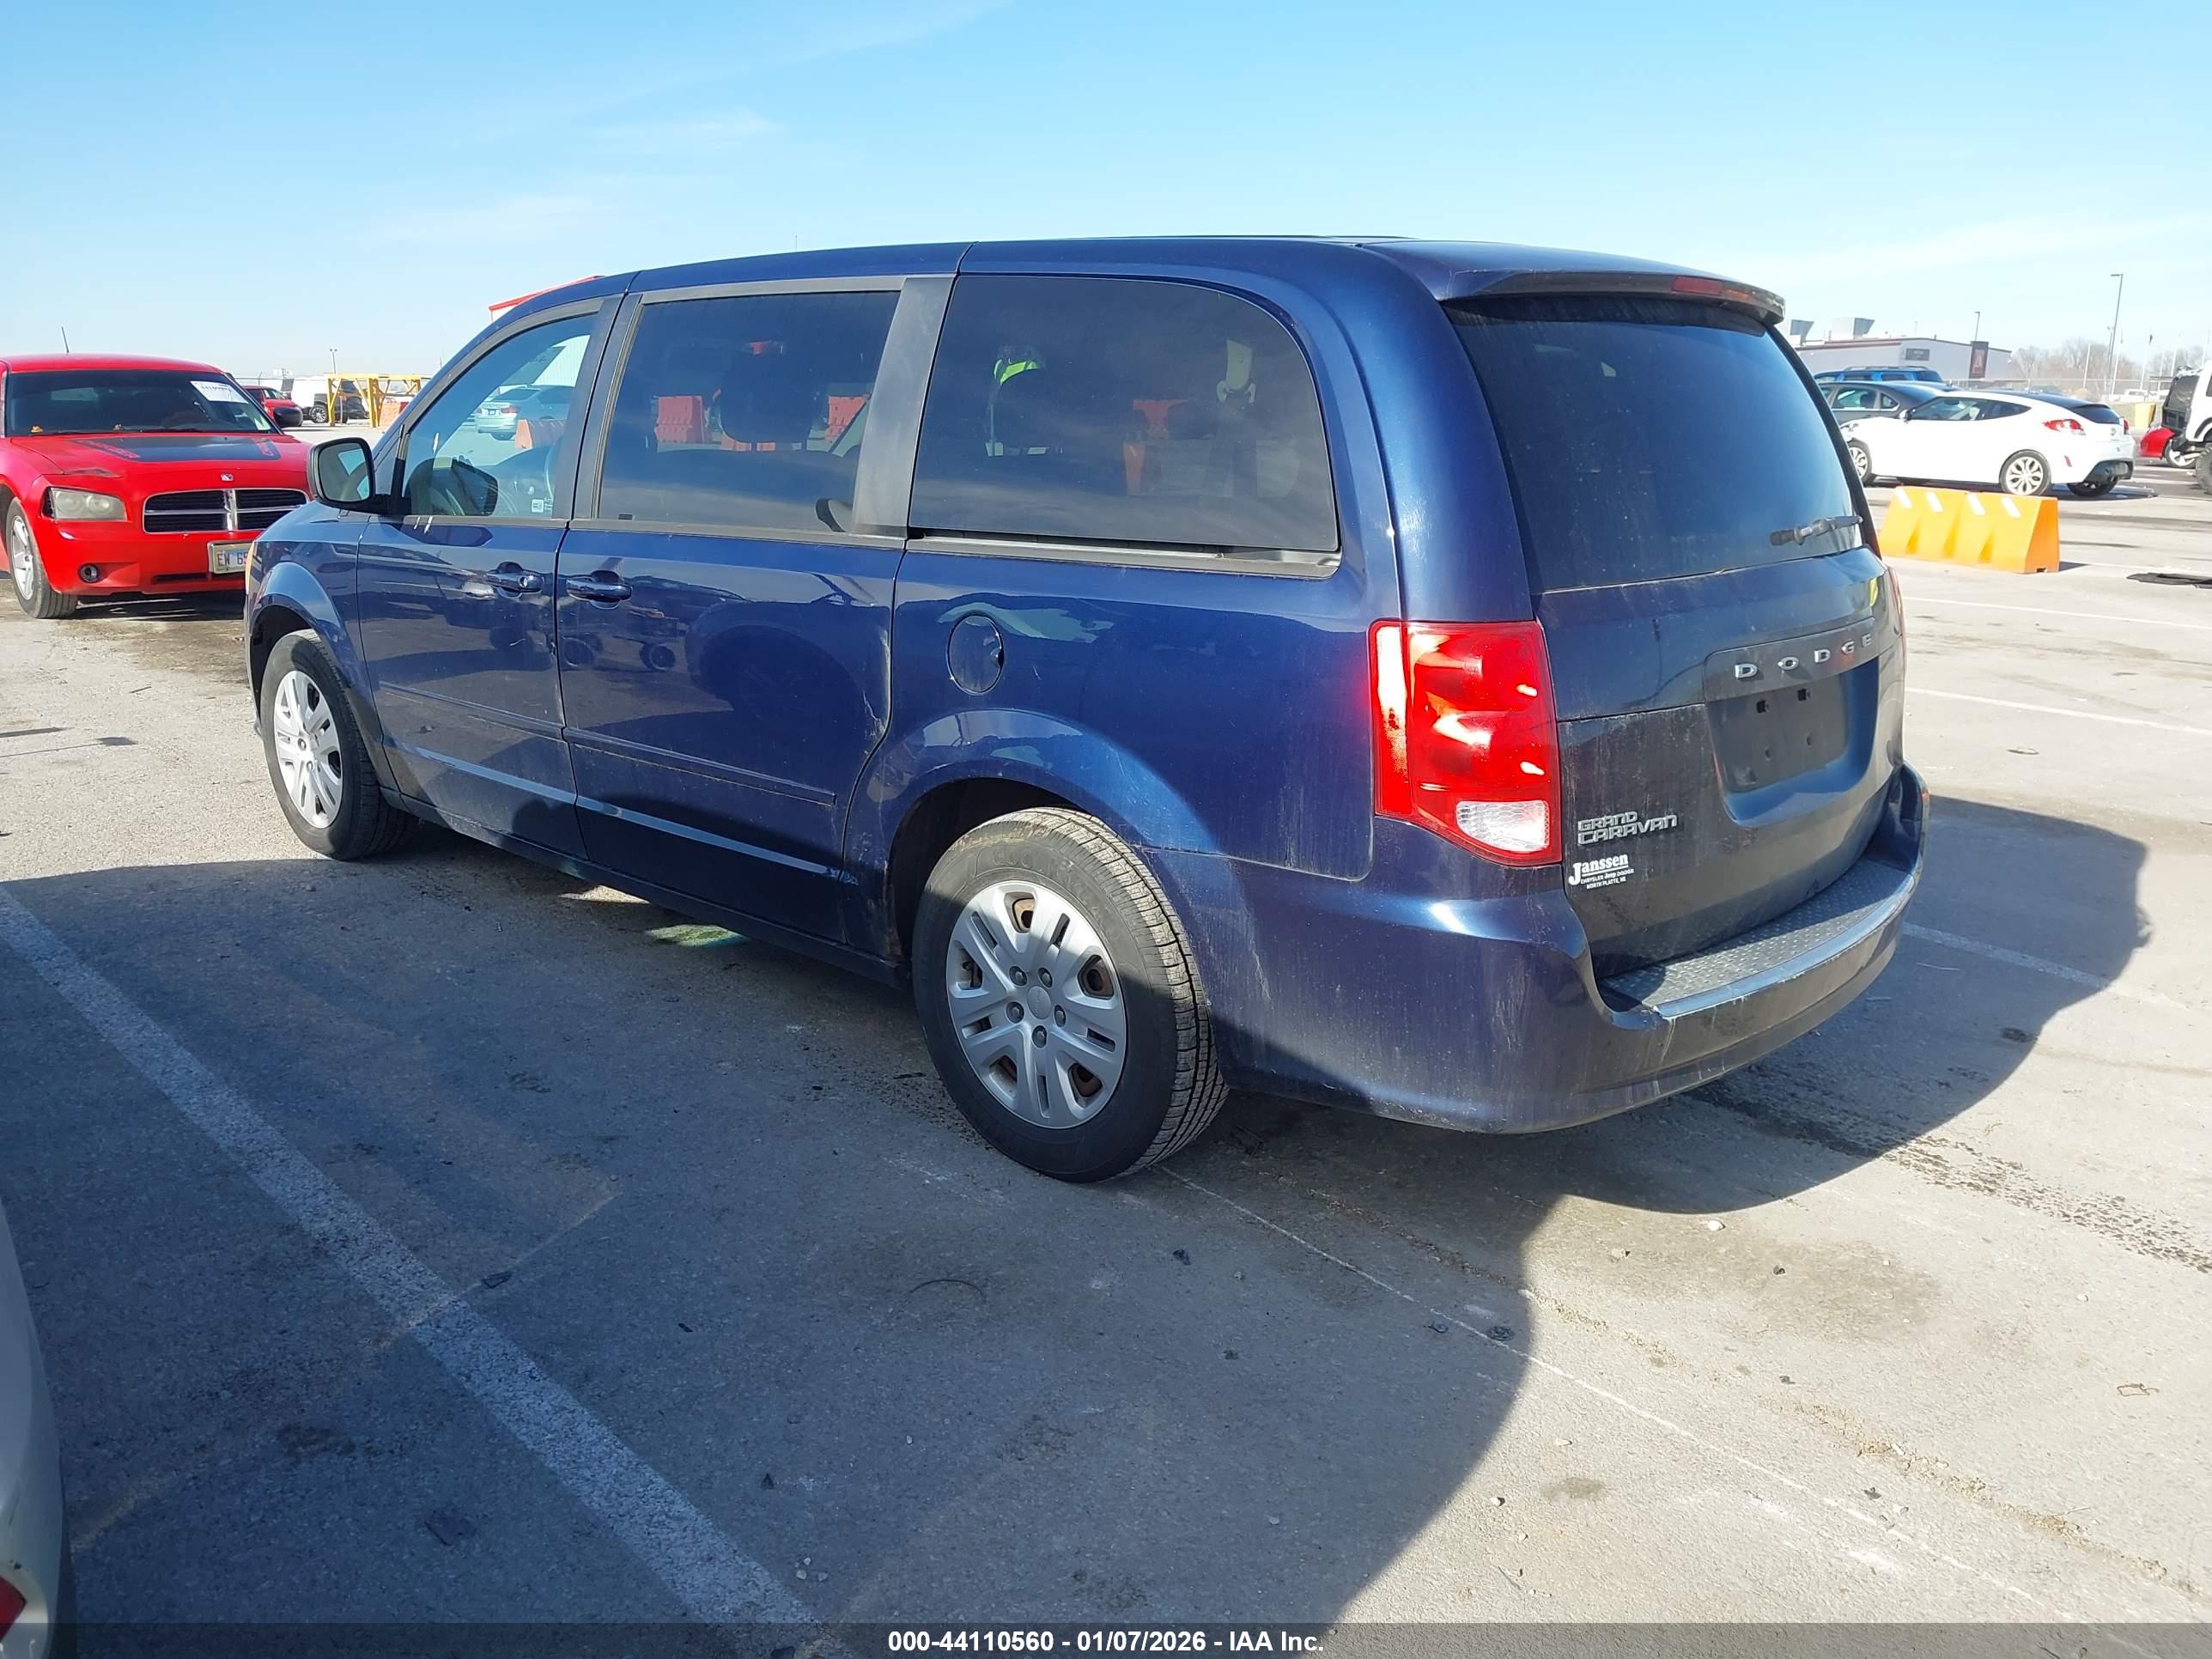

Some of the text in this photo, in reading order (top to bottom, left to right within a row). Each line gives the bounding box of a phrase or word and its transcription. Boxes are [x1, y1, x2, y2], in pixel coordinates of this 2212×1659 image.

[1735, 634, 1872, 678] DODGE
[1577, 811, 1638, 831] GRAND
[1577, 814, 1677, 845] CARAVAN
[1568, 854, 1629, 885] Janssen
